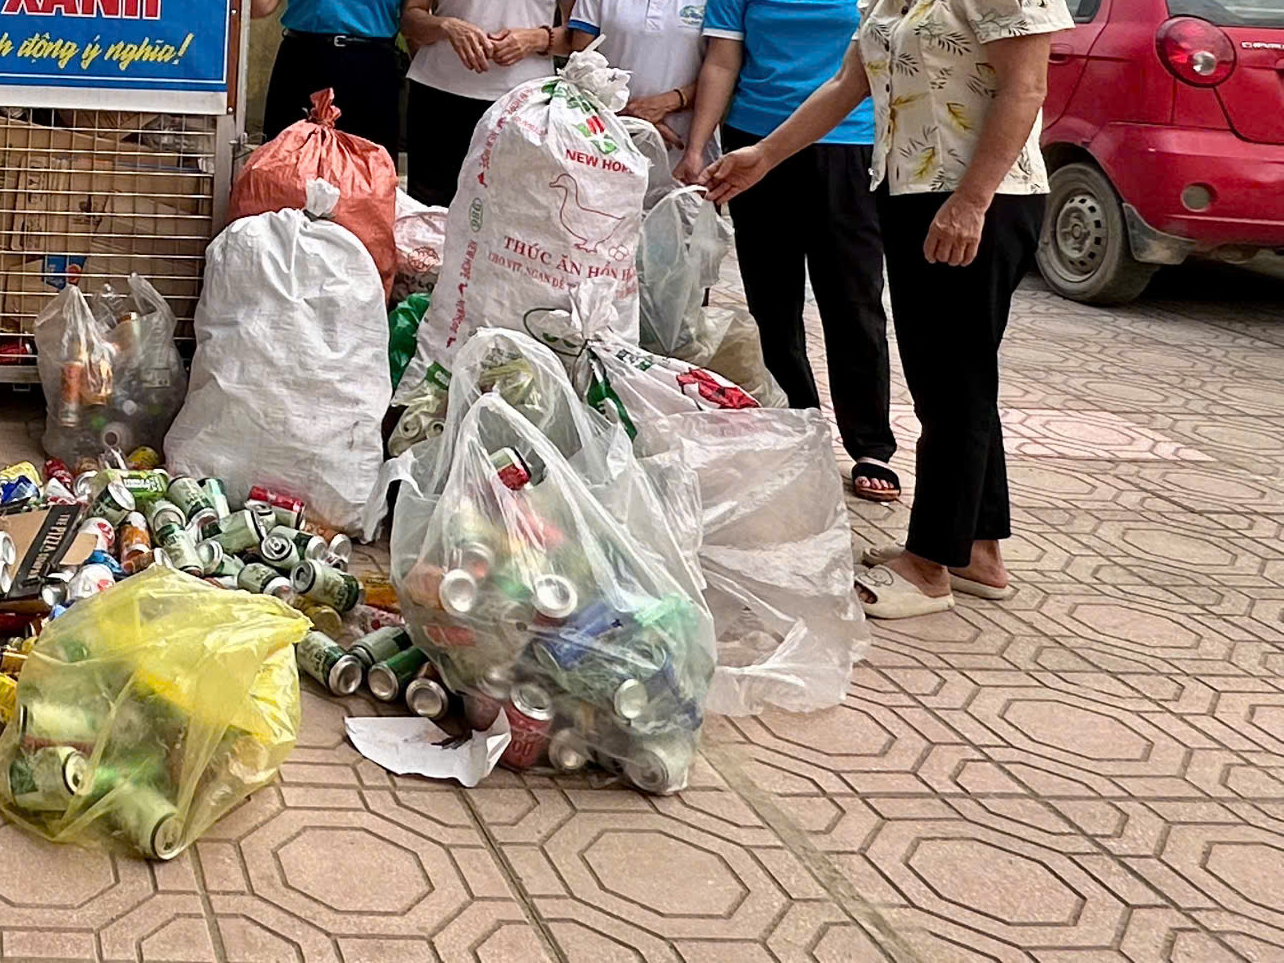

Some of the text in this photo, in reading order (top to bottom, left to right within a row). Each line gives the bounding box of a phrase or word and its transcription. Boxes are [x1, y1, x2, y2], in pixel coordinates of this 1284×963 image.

[17, 31, 80, 70] động
[81, 34, 103, 70] ý
[565, 149, 598, 168] NEW
[504, 236, 552, 265] THỨC
[556, 254, 582, 276] ĂN
[39, 525, 67, 553] PIZZA
